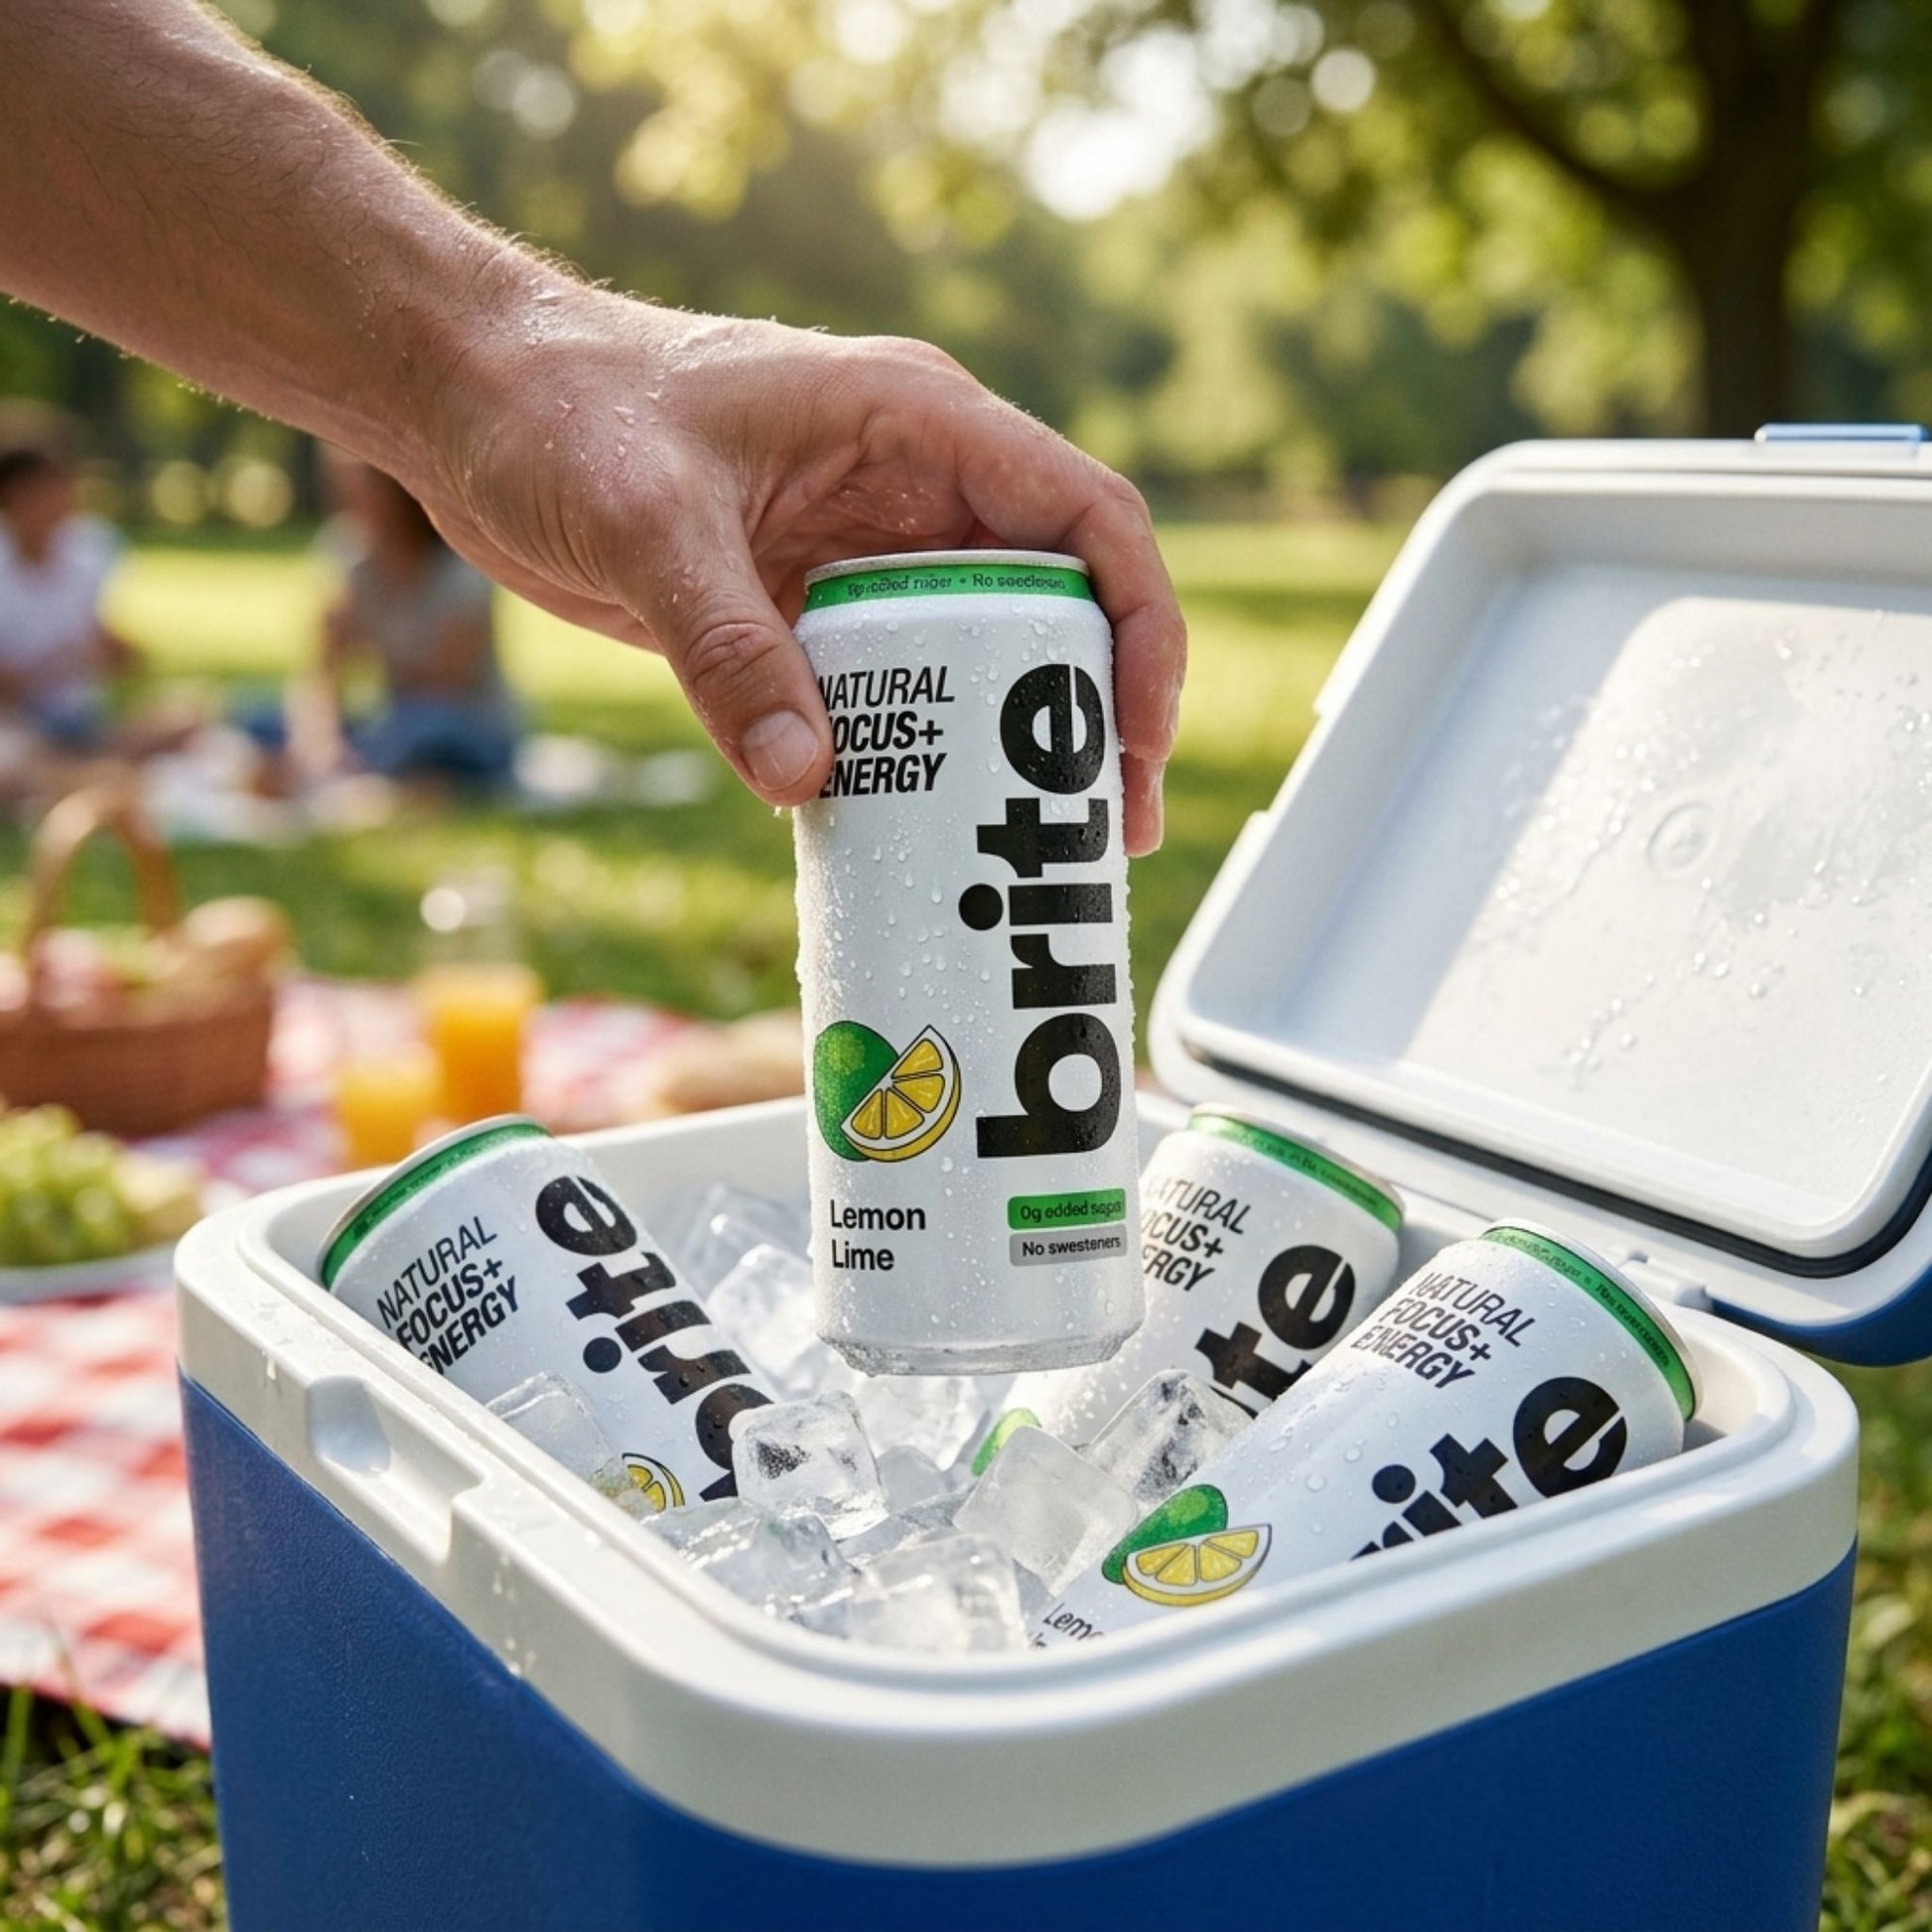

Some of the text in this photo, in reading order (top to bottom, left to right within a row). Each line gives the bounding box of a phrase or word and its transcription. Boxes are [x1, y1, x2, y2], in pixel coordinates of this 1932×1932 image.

[818, 665, 955, 712] NATURAL
[828, 711, 944, 756] OCUS+
[958, 663, 1123, 1159] brite
[830, 1199, 926, 1231] Lemon
[1144, 1174, 1252, 1235] TURAL
[376, 1215, 498, 1330] NATURAL
[831, 1239, 895, 1272] Lime
[1022, 1241, 1044, 1258] No
[396, 1257, 503, 1356] FOCUS+
[1378, 1297, 1492, 1362] FOCUS+
[1408, 1271, 1536, 1348] NATURAL
[1350, 1324, 1475, 1390] ENERGY
[1042, 1601, 1104, 1642] Lem
